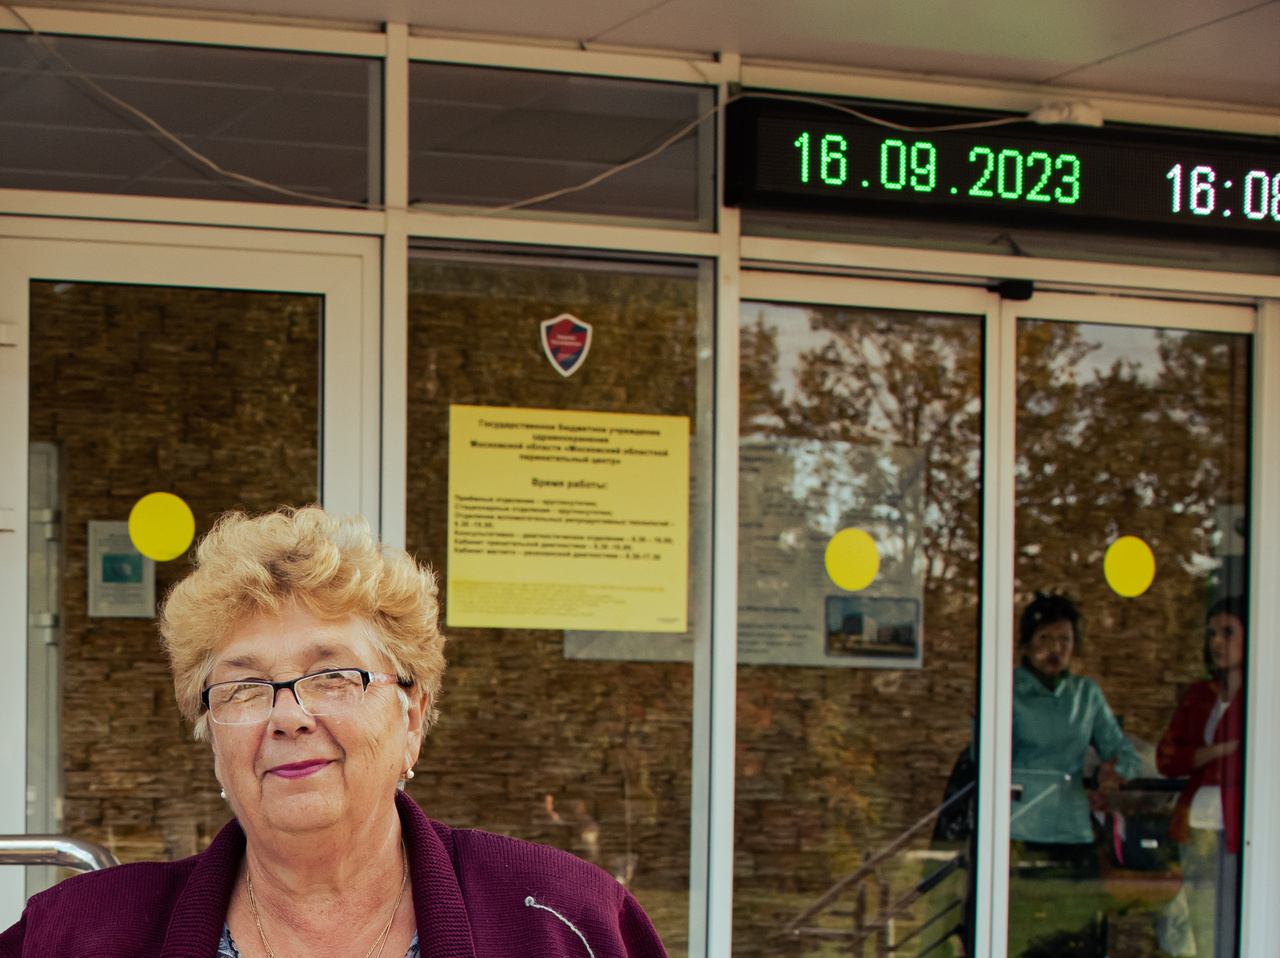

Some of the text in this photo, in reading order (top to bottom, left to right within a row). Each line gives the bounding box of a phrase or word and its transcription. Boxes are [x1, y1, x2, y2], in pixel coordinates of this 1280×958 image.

[794, 132, 1080, 204] 16.09.2023
[531, 477, 608, 490] Время работы:
